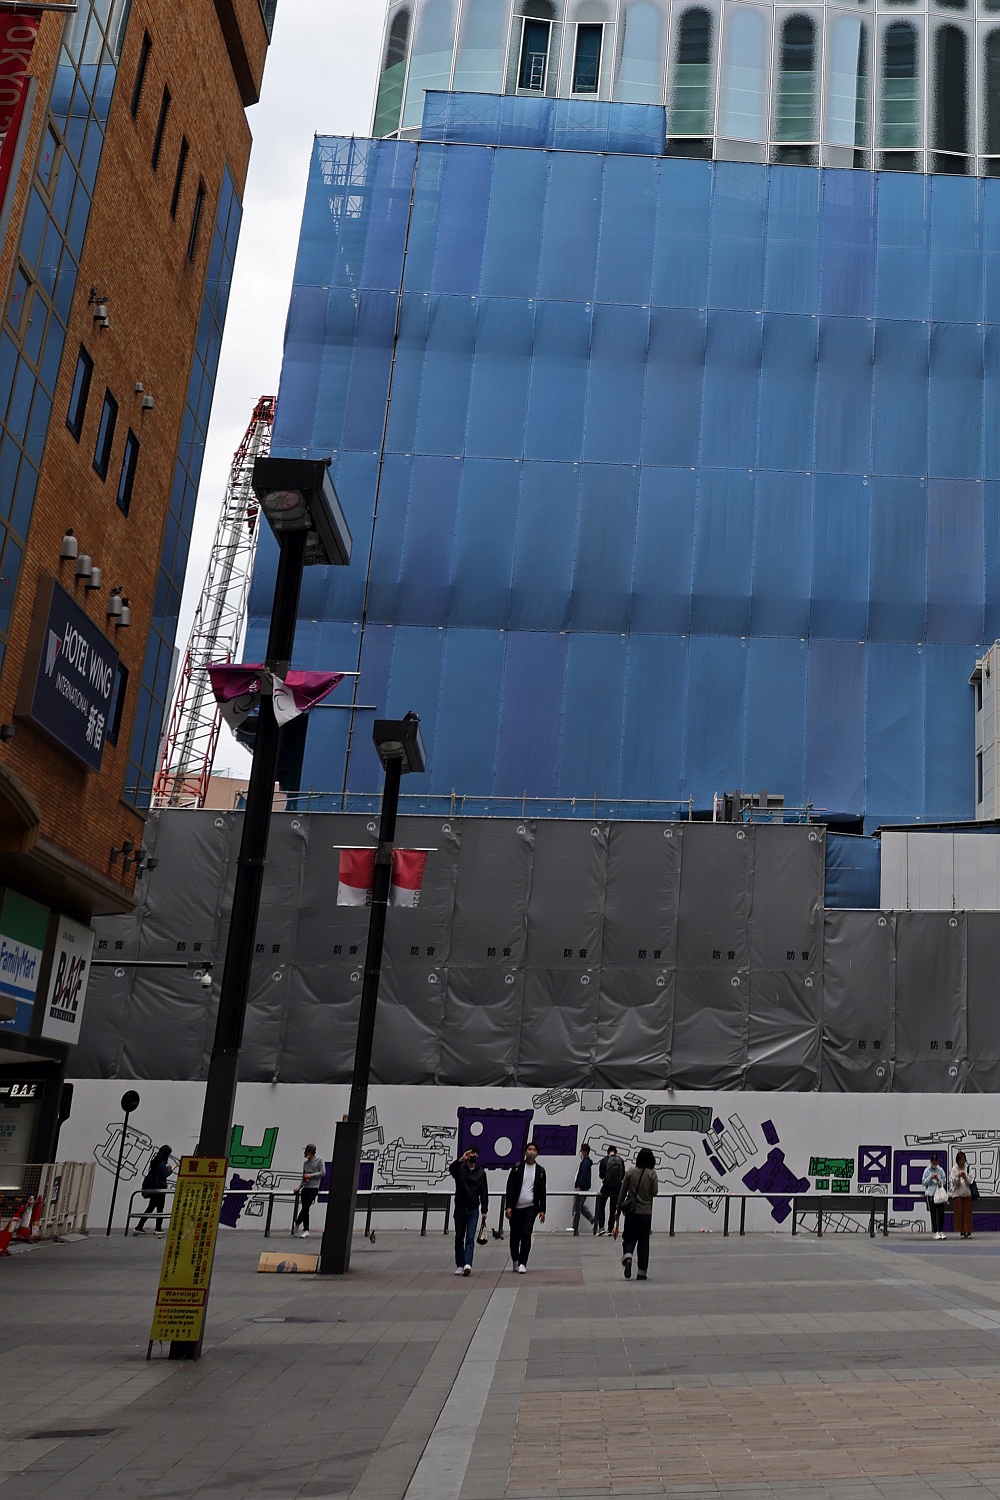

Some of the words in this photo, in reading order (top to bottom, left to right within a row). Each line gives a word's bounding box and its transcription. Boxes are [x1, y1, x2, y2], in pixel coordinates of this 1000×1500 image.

[62, 622, 90, 676] HOTEL
[89, 649, 112, 699] WING
[55, 672, 89, 716] INTERNATIONAL
[86, 704, 105, 751] 新宿
[98, 940, 124, 950] 防音
[177, 942, 202, 952] 防音
[256, 943, 281, 953] 防音
[333, 945, 358, 955] 防音
[411, 946, 435, 956] 防音
[487, 947, 512, 957] 防音
[563, 948, 588, 958] 防音
[638, 949, 662, 959] 防音
[712, 950, 736, 960] 防音
[786, 951, 810, 961] 防音
[0, 941, 36, 982] FamilyMart
[858, 1039, 882, 1049] 防音
[930, 1040, 953, 1050] 防音
[188, 1160, 218, 1173] 警告
